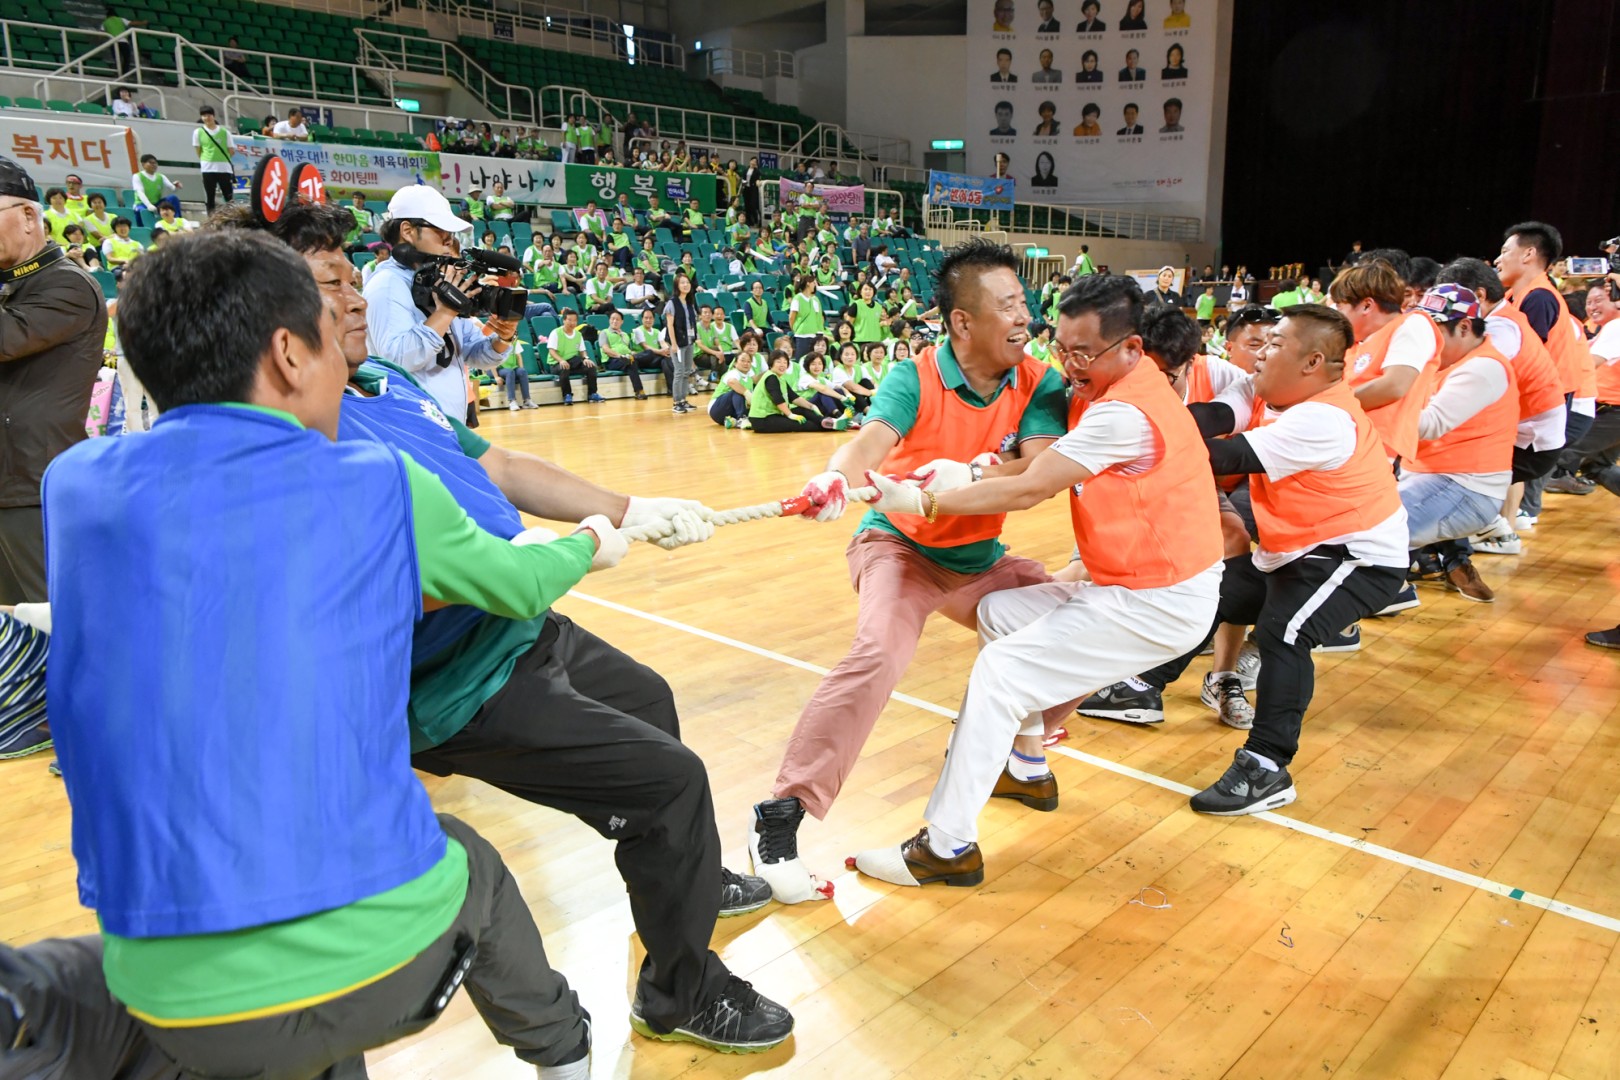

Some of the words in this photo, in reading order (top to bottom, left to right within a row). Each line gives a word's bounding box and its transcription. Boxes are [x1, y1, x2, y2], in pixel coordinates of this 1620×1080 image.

[11, 133, 112, 169] 복지다
[280, 148, 329, 164] 해운대!!
[333, 152, 370, 168] 한마음
[373, 155, 428, 169] 체육대회!!
[264, 161, 285, 211] 최
[331, 169, 379, 186] 화이팅!!!
[13, 261, 40, 277] Nikon
